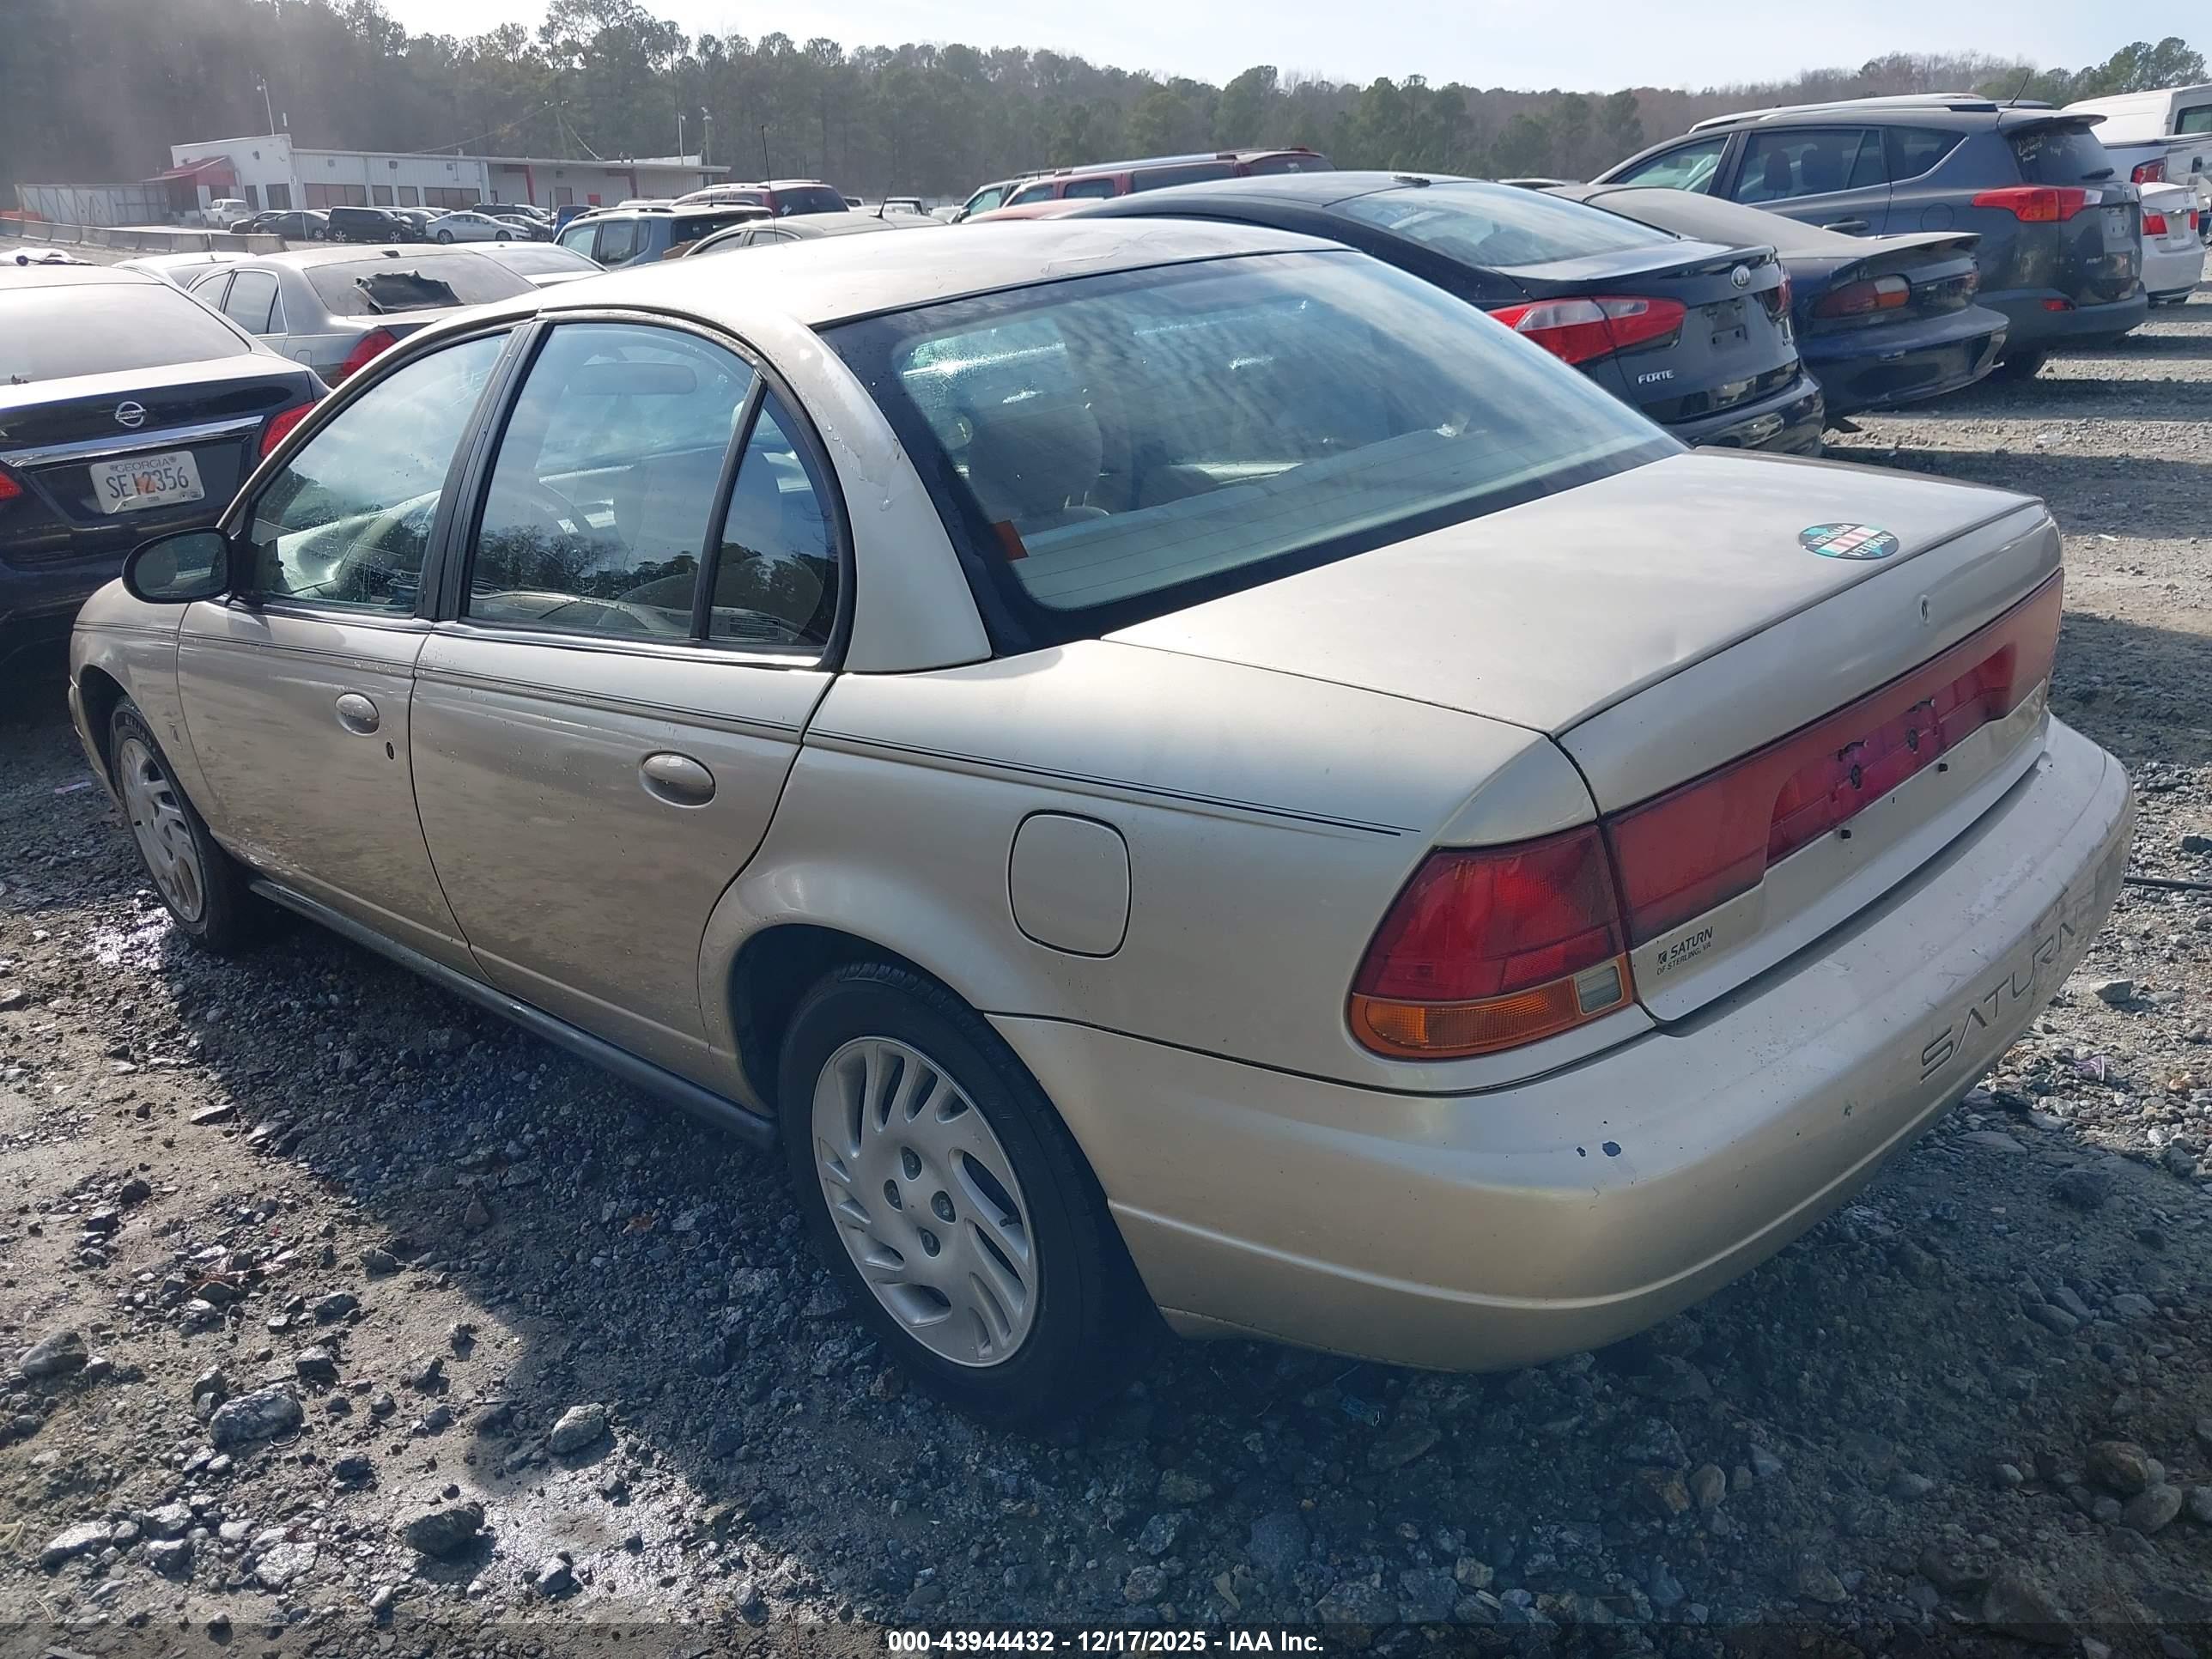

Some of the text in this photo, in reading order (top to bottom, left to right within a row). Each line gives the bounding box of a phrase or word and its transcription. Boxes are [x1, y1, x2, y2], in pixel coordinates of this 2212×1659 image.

[1638, 369, 1674, 385] FORTE
[117, 458, 170, 472] GEORGIA
[1848, 533, 1894, 556] VETERAN
[1670, 927, 1713, 959] SATURN
[1656, 966, 1666, 975] OF
[1919, 905, 2078, 1085] SATURN
